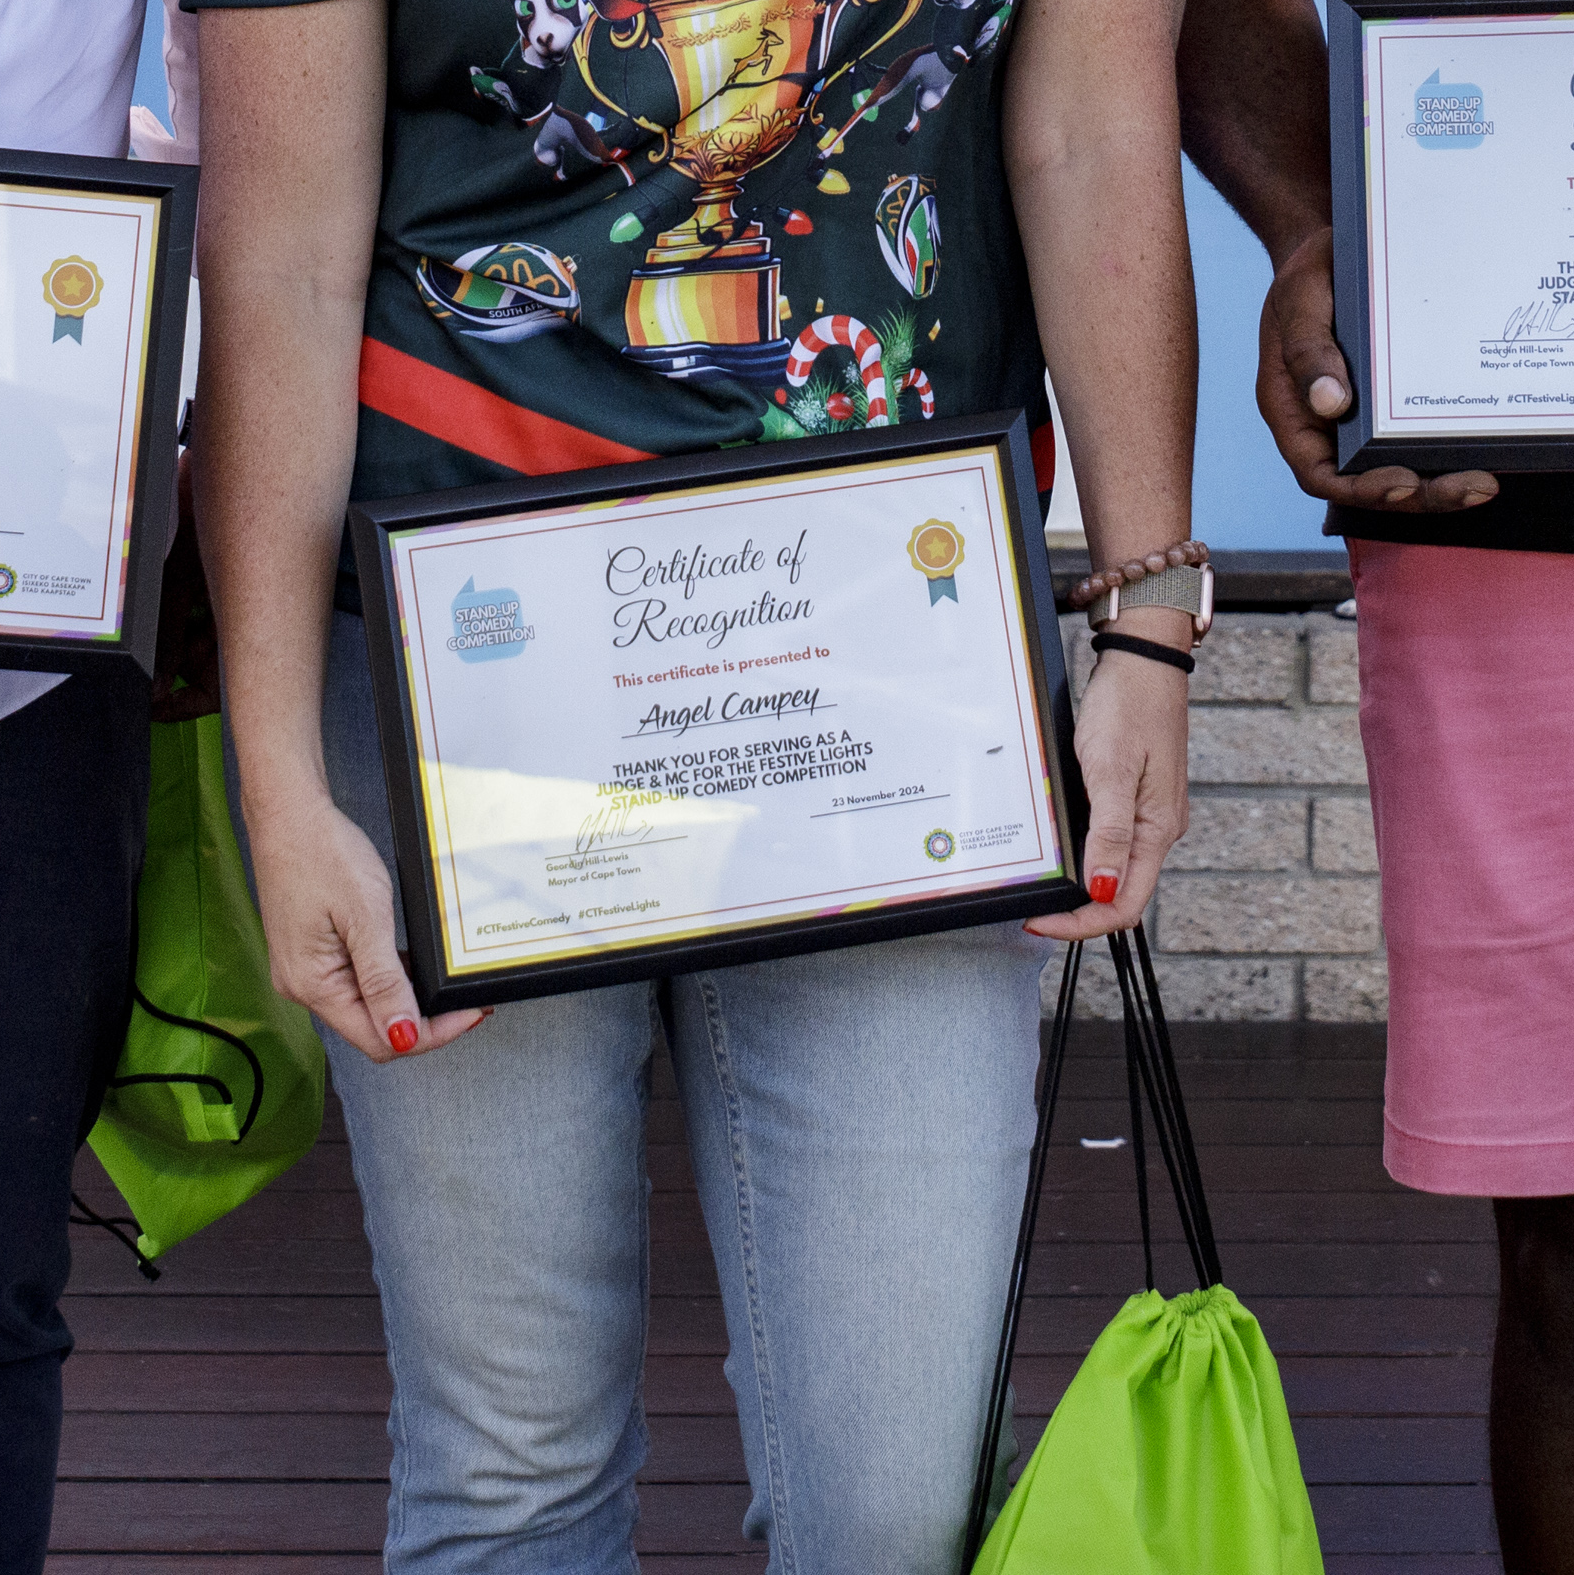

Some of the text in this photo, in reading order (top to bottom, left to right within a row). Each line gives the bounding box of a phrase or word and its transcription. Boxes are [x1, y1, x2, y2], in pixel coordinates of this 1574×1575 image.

[1417, 95, 1482, 112] STAND-UP
[1422, 108, 1478, 124] COMEDY
[1406, 120, 1495, 138] COMPETITION
[489, 308, 523, 318] SOUTH
[1519, 344, 1564, 354] Hill-Lewis
[1480, 359, 1574, 370] Mayor of Cape Town
[1404, 394, 1499, 406] #CTFestiveComedy
[605, 529, 807, 600] Certificate of
[40, 588, 76, 596] KAAPSTAD
[453, 600, 521, 625] STAND-UP
[612, 590, 813, 650] Recognition
[460, 614, 518, 637] COMEDY
[445, 625, 536, 654] COMPETITION
[613, 646, 830, 688] This certificate is presented to
[638, 688, 820, 738] Angel Campey
[613, 730, 852, 778] THANK YOU FOR SERVING AS A
[596, 742, 873, 797] JUDGE & MC FOR THE FESTIVE LIGHTS
[610, 758, 867, 812] STAND-UP COMEDY COMPETITION
[832, 784, 925, 807] 23 November 2024
[585, 854, 629, 866] Hill-Lewis
[548, 867, 641, 887] Mayor of Cape Town
[476, 899, 660, 936] #CTFestiveComedy #CTFestiveLights
